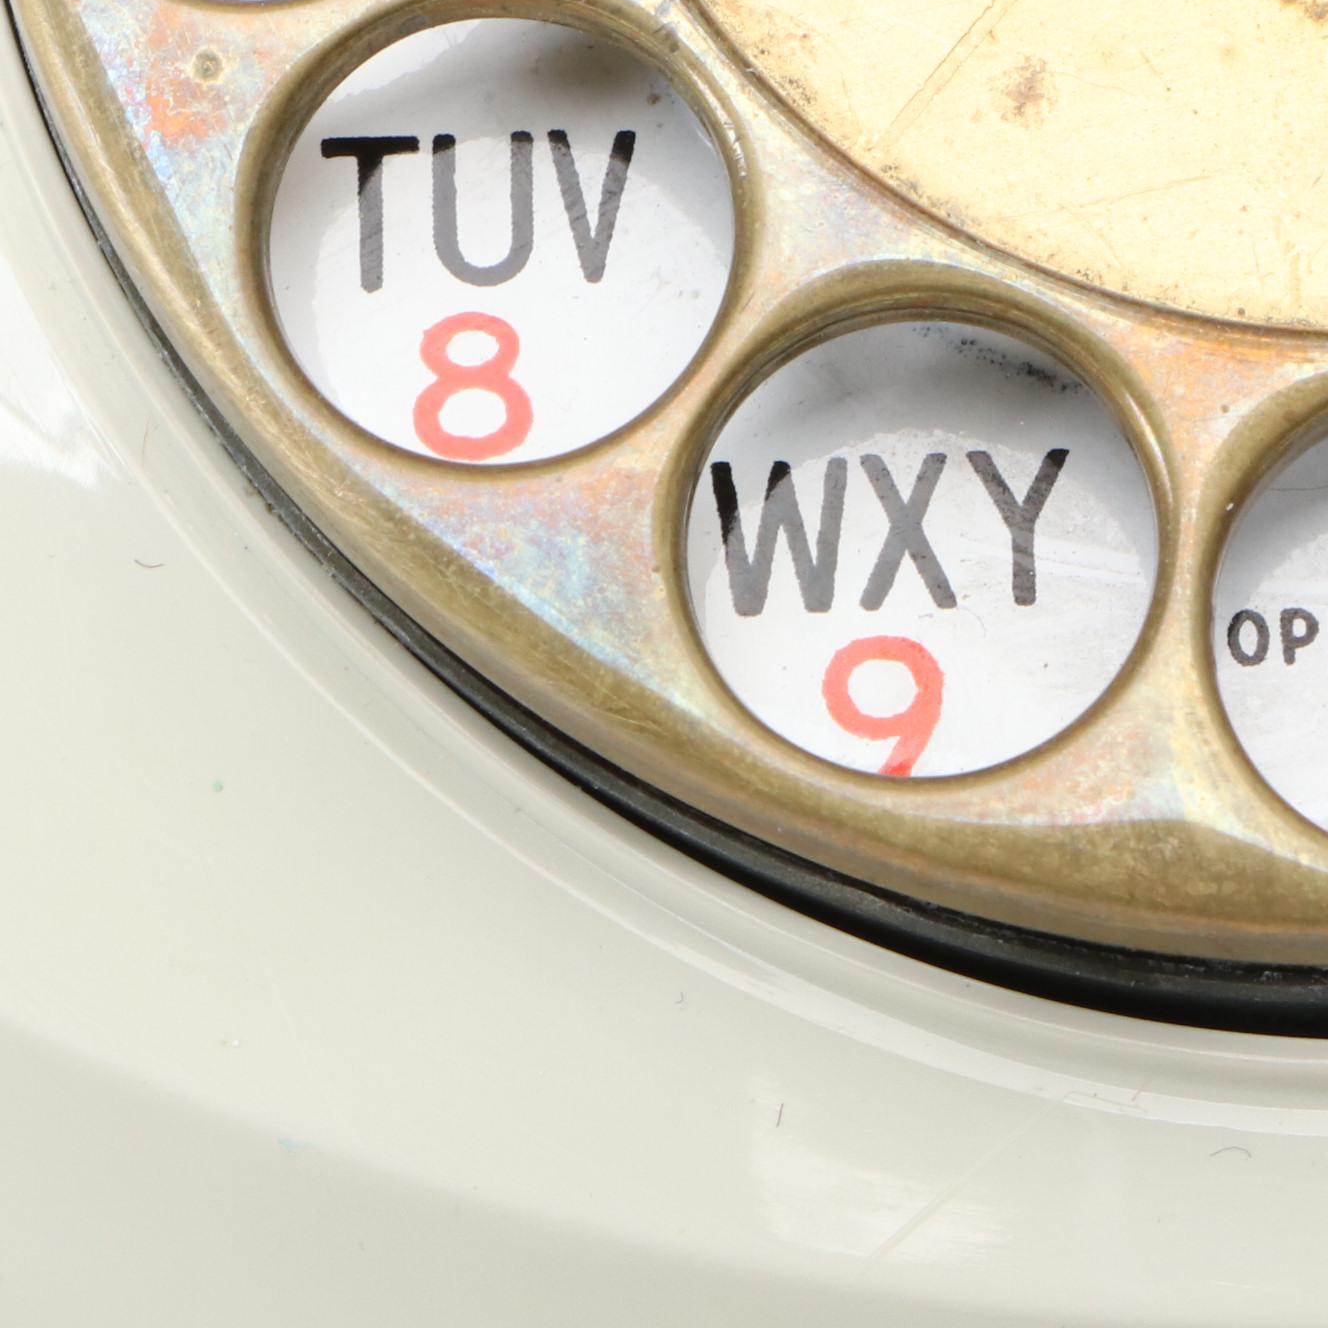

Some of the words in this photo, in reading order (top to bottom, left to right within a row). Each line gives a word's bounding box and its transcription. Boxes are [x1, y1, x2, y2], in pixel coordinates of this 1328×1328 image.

[320, 128, 637, 293] TUV
[411, 312, 534, 462] 8
[709, 447, 1070, 617] WXY
[822, 635, 944, 777] 9
